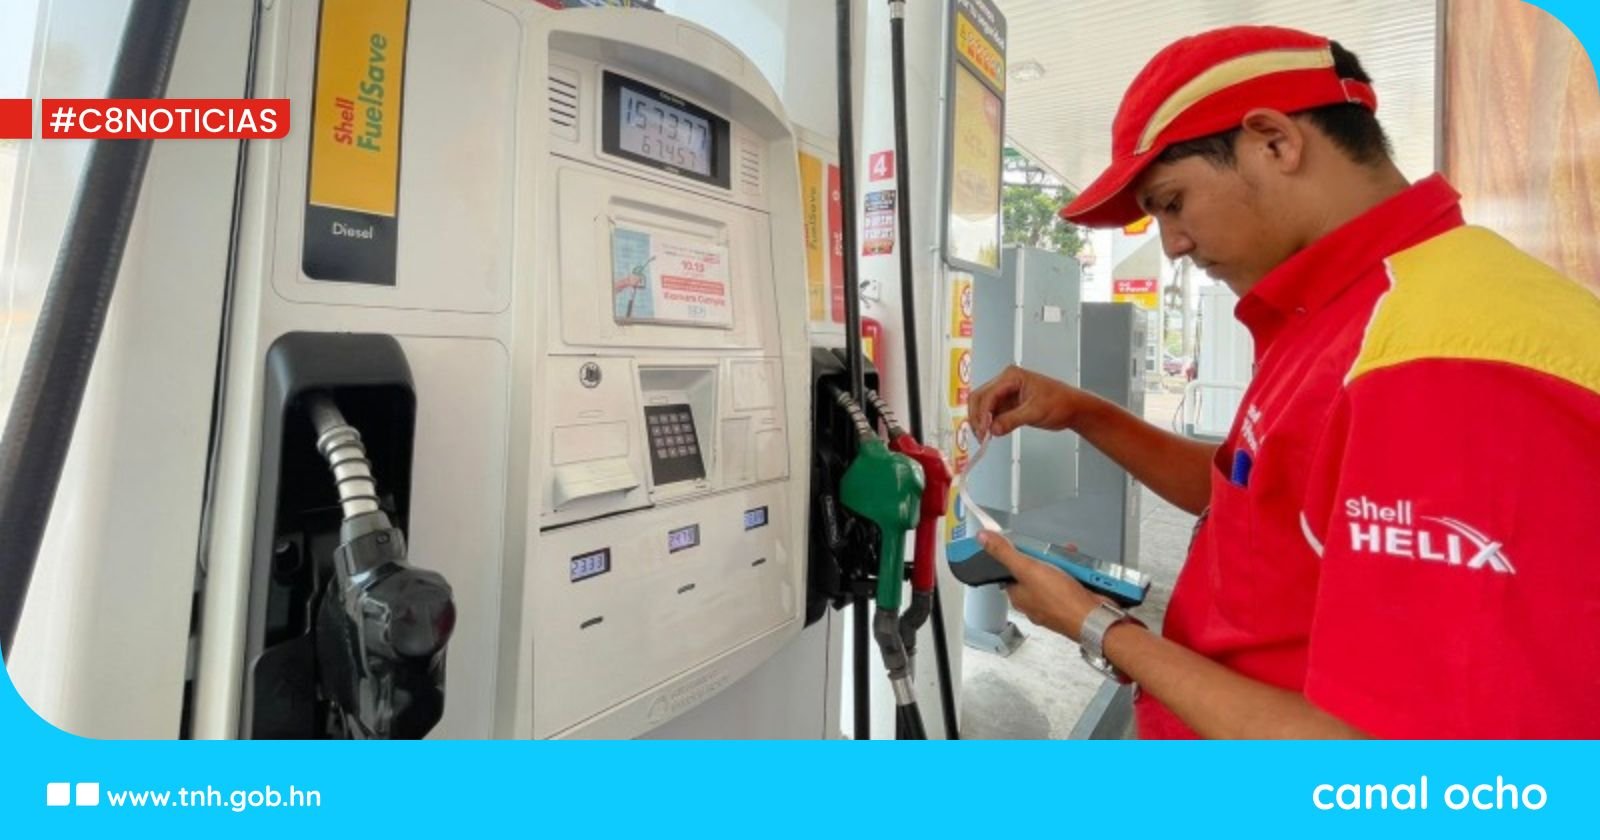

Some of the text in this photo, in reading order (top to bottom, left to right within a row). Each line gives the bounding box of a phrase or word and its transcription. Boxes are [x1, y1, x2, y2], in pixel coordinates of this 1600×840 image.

[356, 32, 387, 153] FuelSave
[333, 96, 354, 146] Shell
[873, 154, 888, 177] 4
[331, 221, 374, 240] Diesel
[1349, 521, 1512, 574] HELIX
